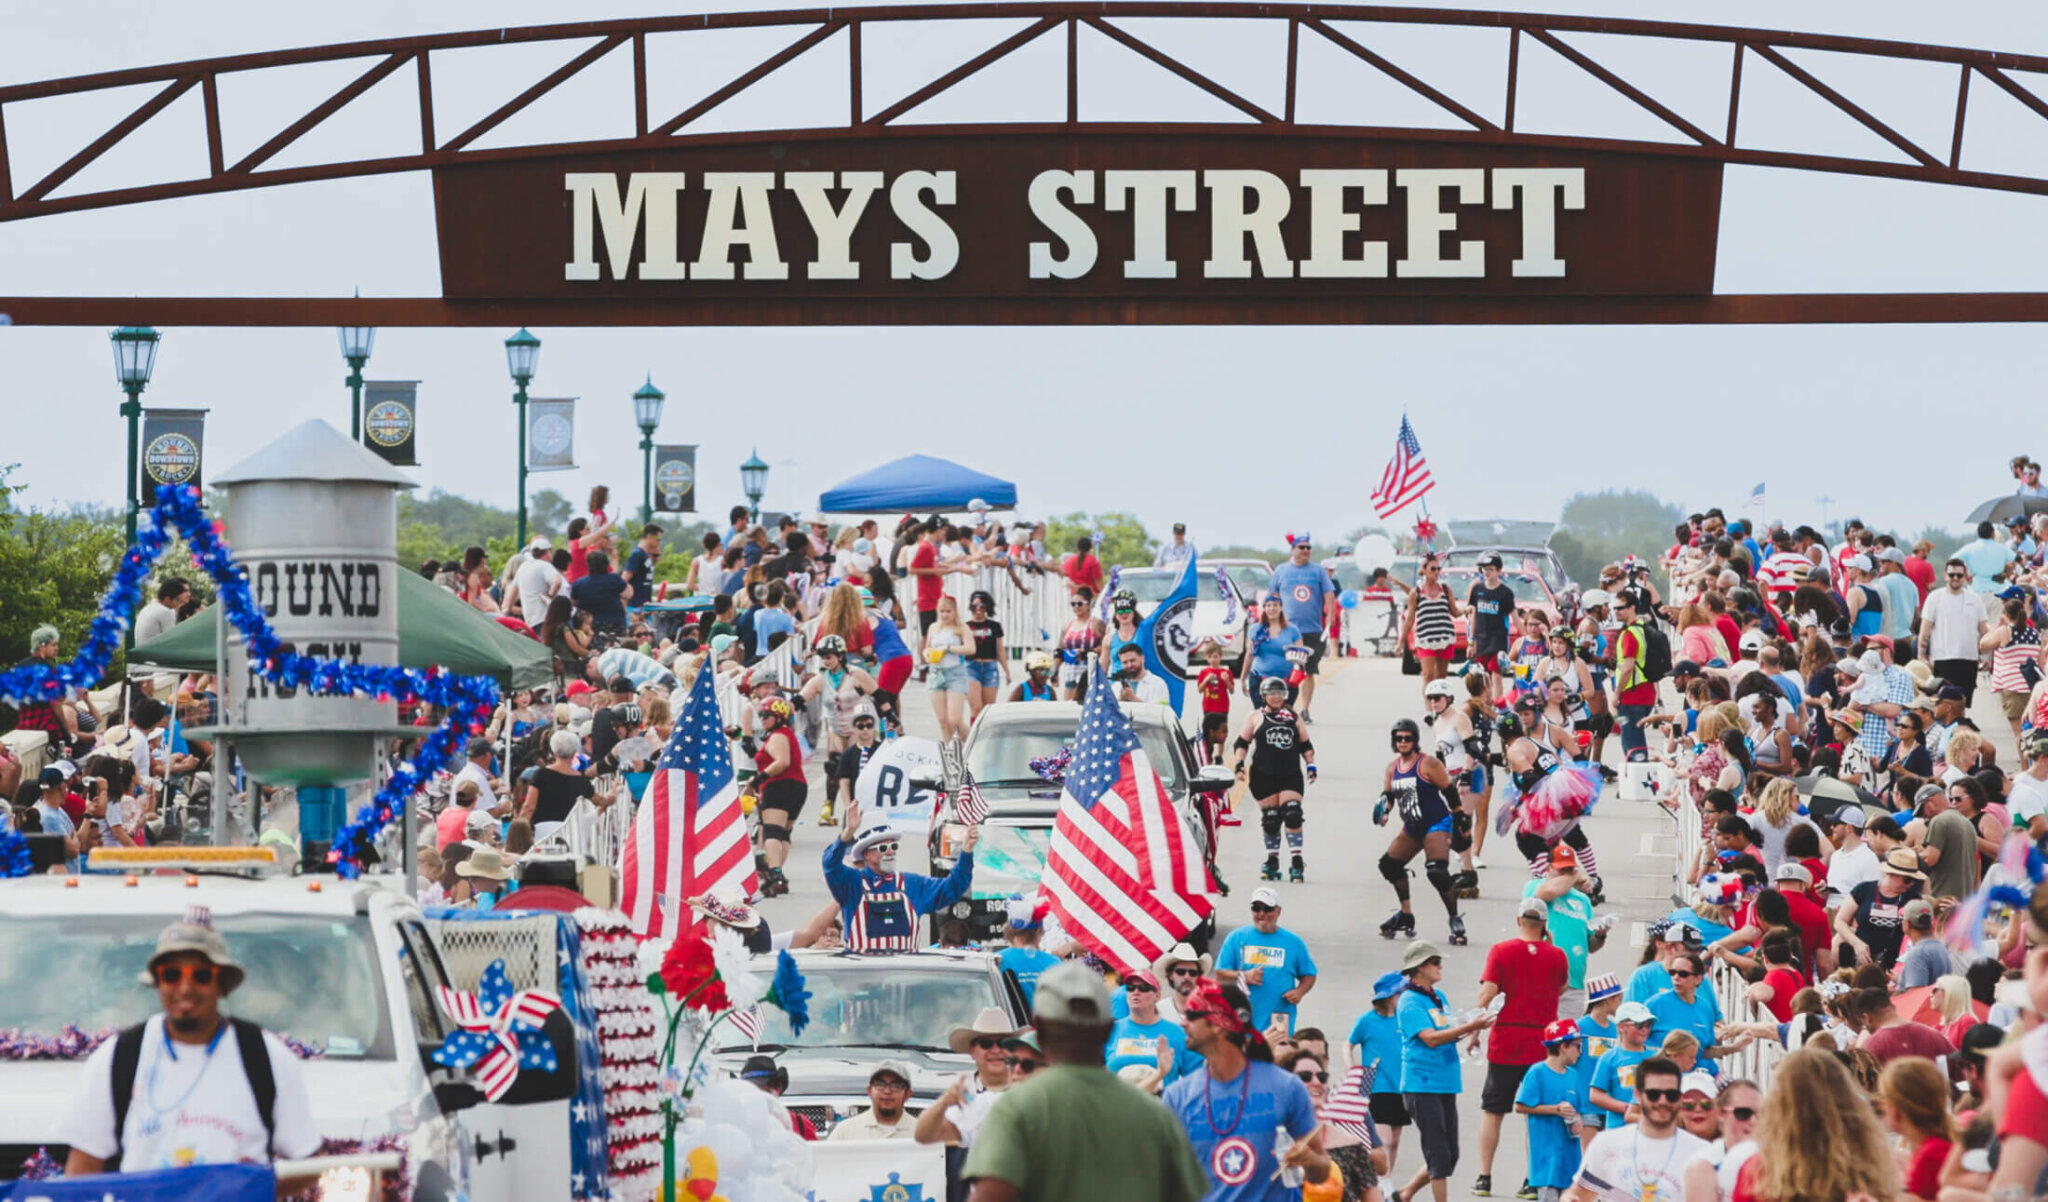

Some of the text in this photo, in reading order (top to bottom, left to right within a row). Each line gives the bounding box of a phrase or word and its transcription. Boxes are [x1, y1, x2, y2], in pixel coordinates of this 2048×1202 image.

[564, 167, 1586, 281] MAYS STREET
[155, 440, 190, 451] ROUND
[149, 455, 194, 463] DOWNTOWN
[159, 471, 185, 480] ROCK
[237, 562, 381, 618] OUND
